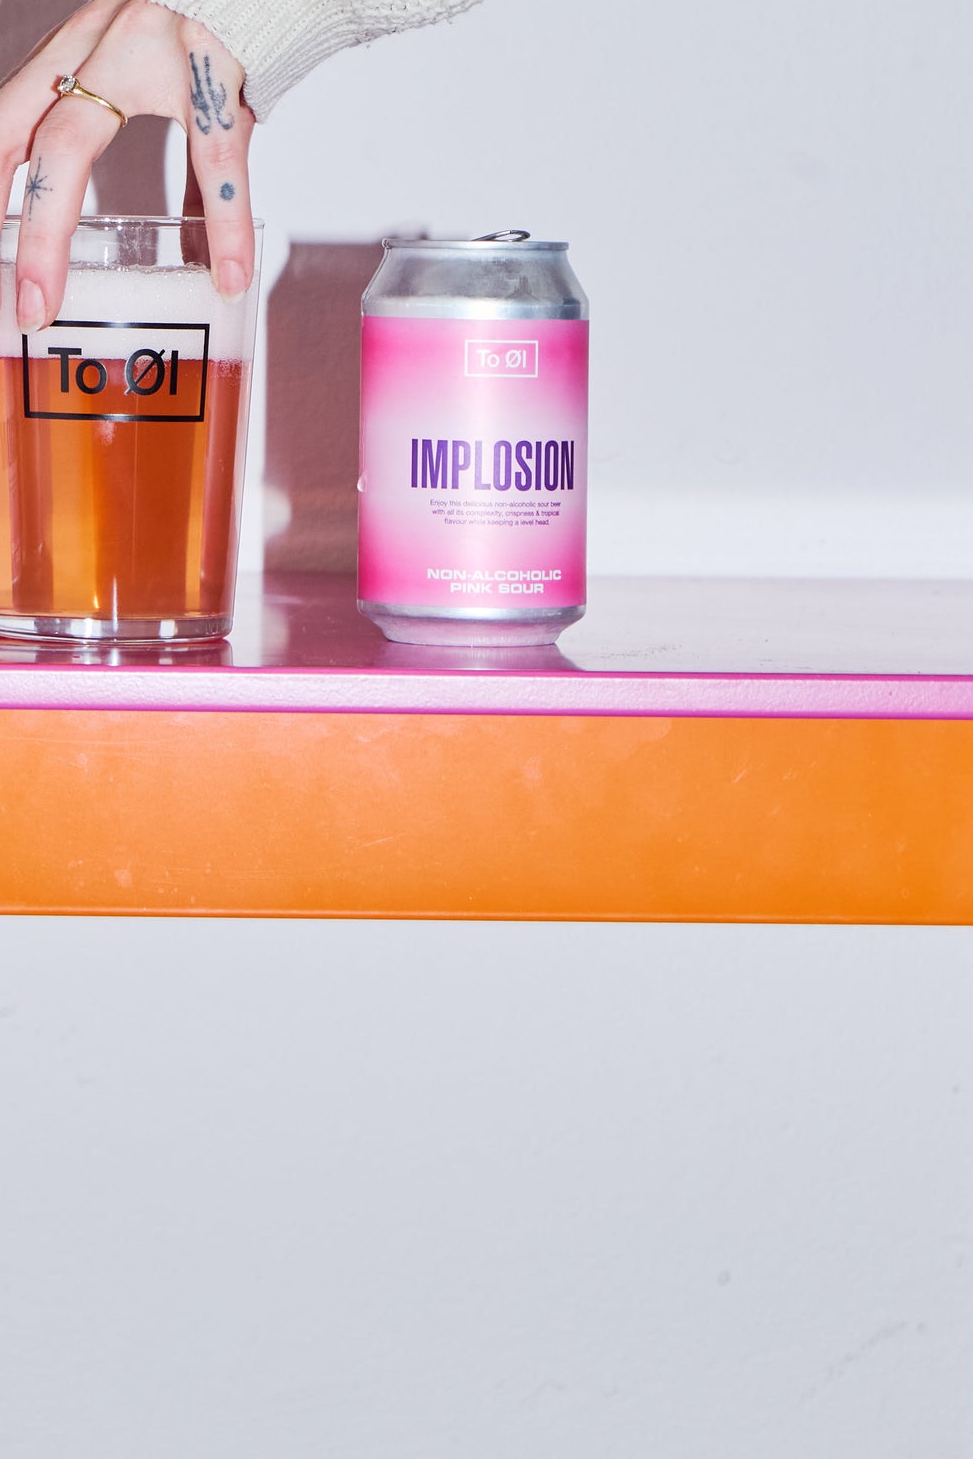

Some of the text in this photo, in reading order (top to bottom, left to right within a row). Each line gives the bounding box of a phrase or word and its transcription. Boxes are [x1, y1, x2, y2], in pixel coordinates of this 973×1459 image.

[475, 349, 500, 368] To
[47, 346, 108, 395] To
[410, 438, 575, 491] IMPLOSION
[429, 499, 448, 507] Enjoy
[494, 500, 536, 508] non-alcoholic
[446, 508, 455, 516] all
[504, 510, 534, 518] crispness
[444, 517, 467, 525] flavour
[487, 518, 514, 527] keeping
[427, 568, 562, 581] NON-ALCOHOLIC
[450, 582, 544, 594] PINK SOUR
